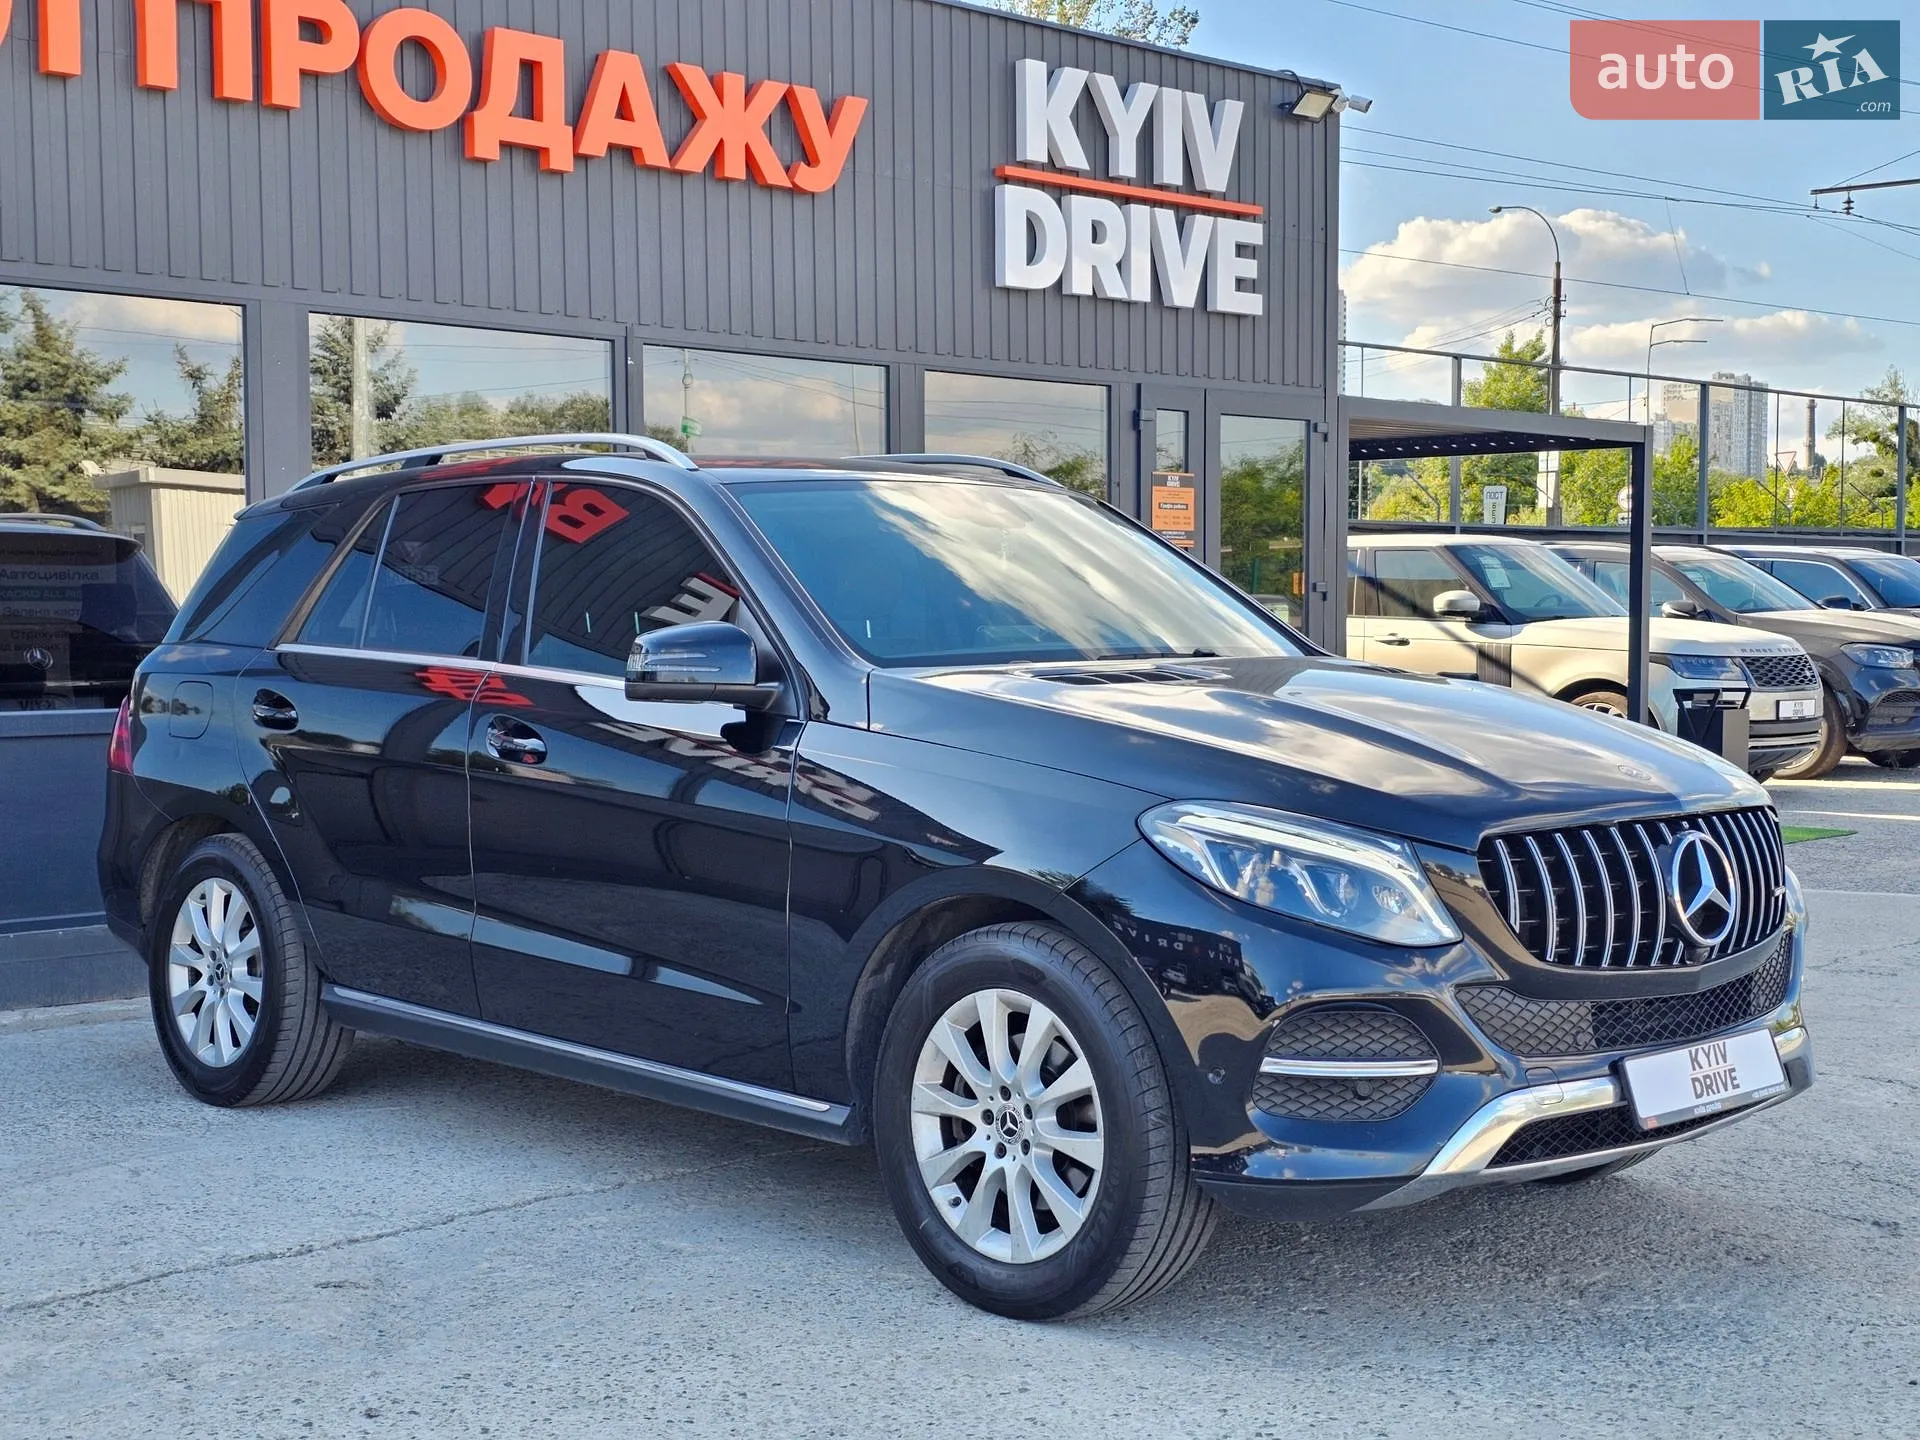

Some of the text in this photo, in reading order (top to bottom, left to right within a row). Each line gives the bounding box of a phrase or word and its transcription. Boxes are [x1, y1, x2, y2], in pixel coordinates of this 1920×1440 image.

[135, 0, 868, 193] ПРОДАЖУ
[1015, 58, 1245, 193] KYIV
[994, 183, 1264, 316] DRIVE
[1688, 1041, 1728, 1071] KYIV
[1690, 1068, 1740, 1099] DRIVE
